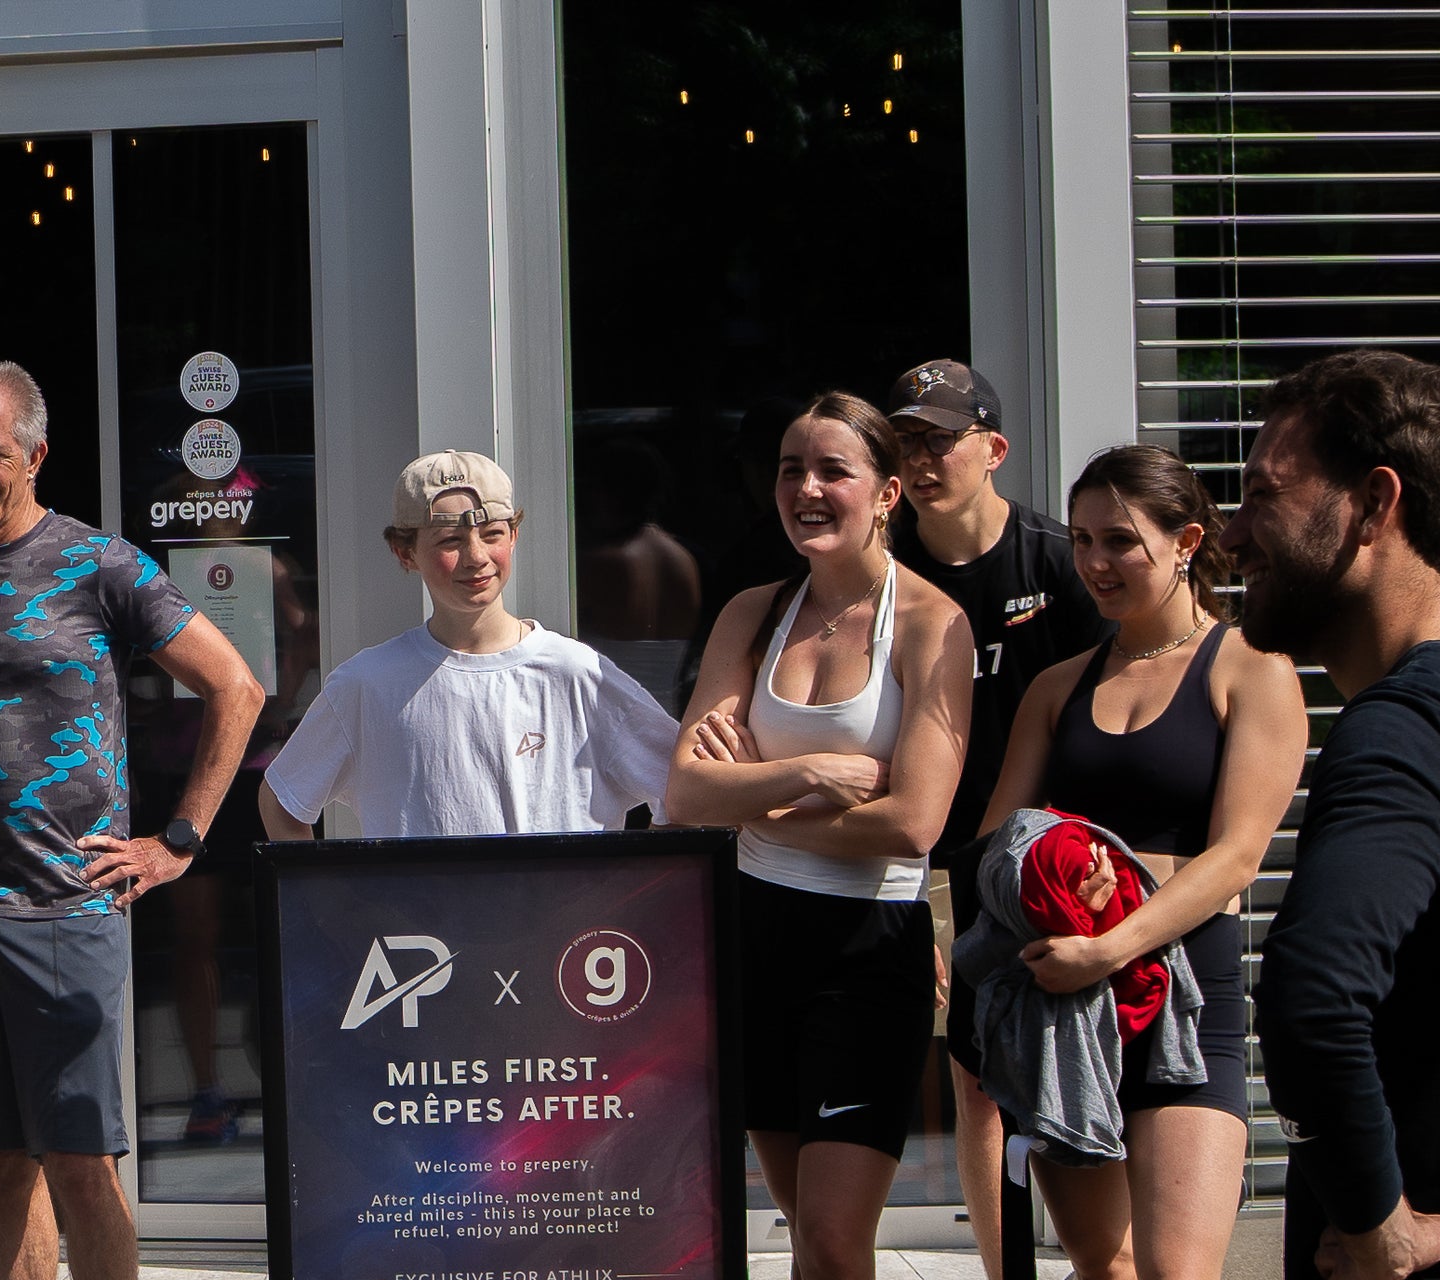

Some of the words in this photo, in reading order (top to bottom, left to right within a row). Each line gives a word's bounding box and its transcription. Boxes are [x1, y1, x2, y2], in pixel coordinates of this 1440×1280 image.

[191, 374, 229, 382] GUEST
[189, 383, 232, 393] AWARD
[192, 441, 230, 450] GUEST
[190, 450, 233, 460] AWARD
[186, 490, 215, 500] crêpes
[218, 490, 224, 498] &
[226, 488, 253, 497] drinks
[150, 500, 254, 527] grepery
[215, 569, 227, 585] g
[584, 946, 626, 1006] g
[387, 1060, 489, 1087] MILES
[506, 1057, 610, 1083] FIRST.
[372, 1092, 504, 1125] CRÊPES
[519, 1095, 636, 1121] AFTER.
[415, 1160, 493, 1174] Welcome
[499, 1159, 517, 1172] to
[523, 1159, 595, 1174] grepery.
[371, 1194, 416, 1207] After
[422, 1191, 510, 1207] discipline,
[516, 1189, 604, 1203] movement
[611, 1187, 641, 1201] and
[357, 1208, 413, 1223] shared
[420, 1208, 464, 1222] miles
[484, 1206, 515, 1220] this
[522, 1206, 536, 1219] is
[542, 1207, 581, 1222] your
[587, 1204, 631, 1221] place
[638, 1204, 655, 1217] to
[394, 1223, 450, 1239] refuel,
[457, 1224, 503, 1239] enjoy
[509, 1222, 539, 1236] and
[546, 1220, 619, 1235] connect!
